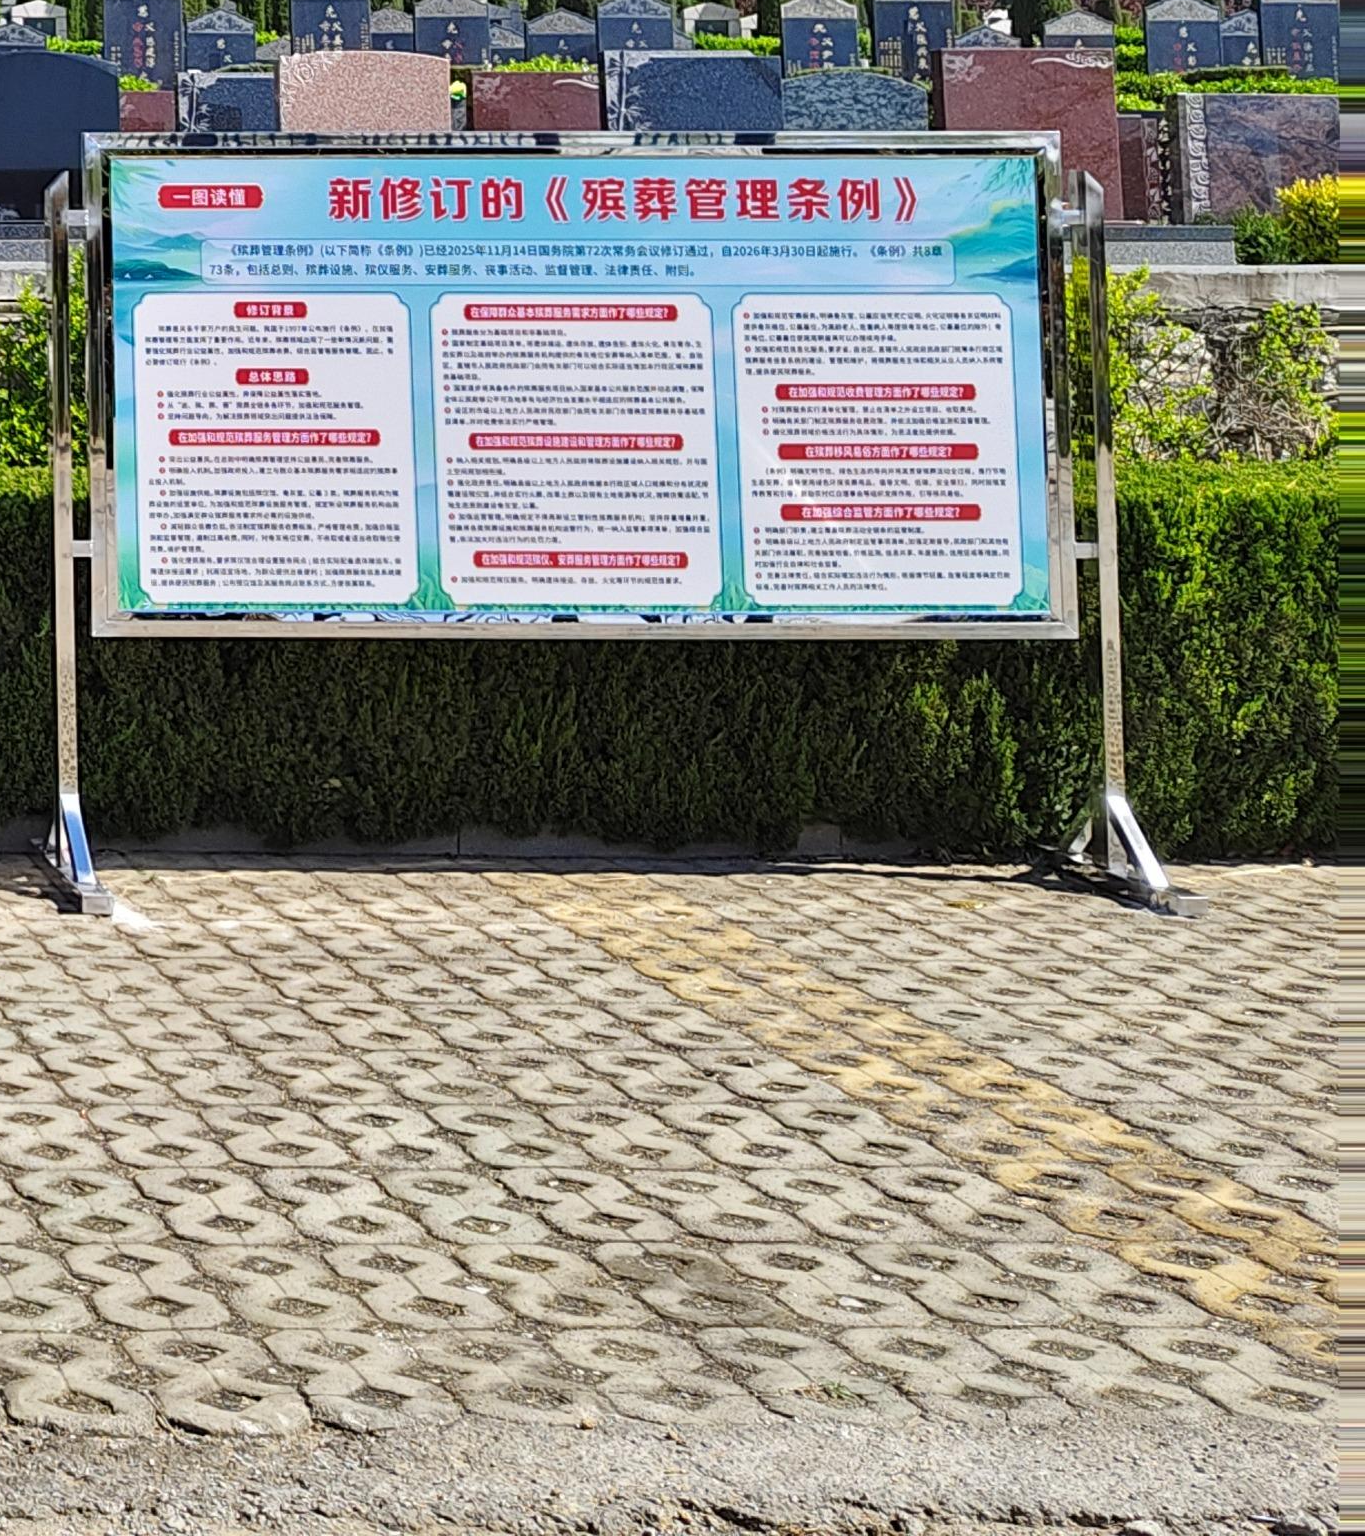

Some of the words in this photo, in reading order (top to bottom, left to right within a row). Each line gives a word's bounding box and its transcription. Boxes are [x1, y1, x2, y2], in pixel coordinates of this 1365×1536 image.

[173, 189, 247, 207] 一图读懂
[328, 177, 918, 222] 新修订的《殡葬管理条例》
[246, 305, 294, 317] 修订背景
[248, 371, 297, 383] 总体思路
